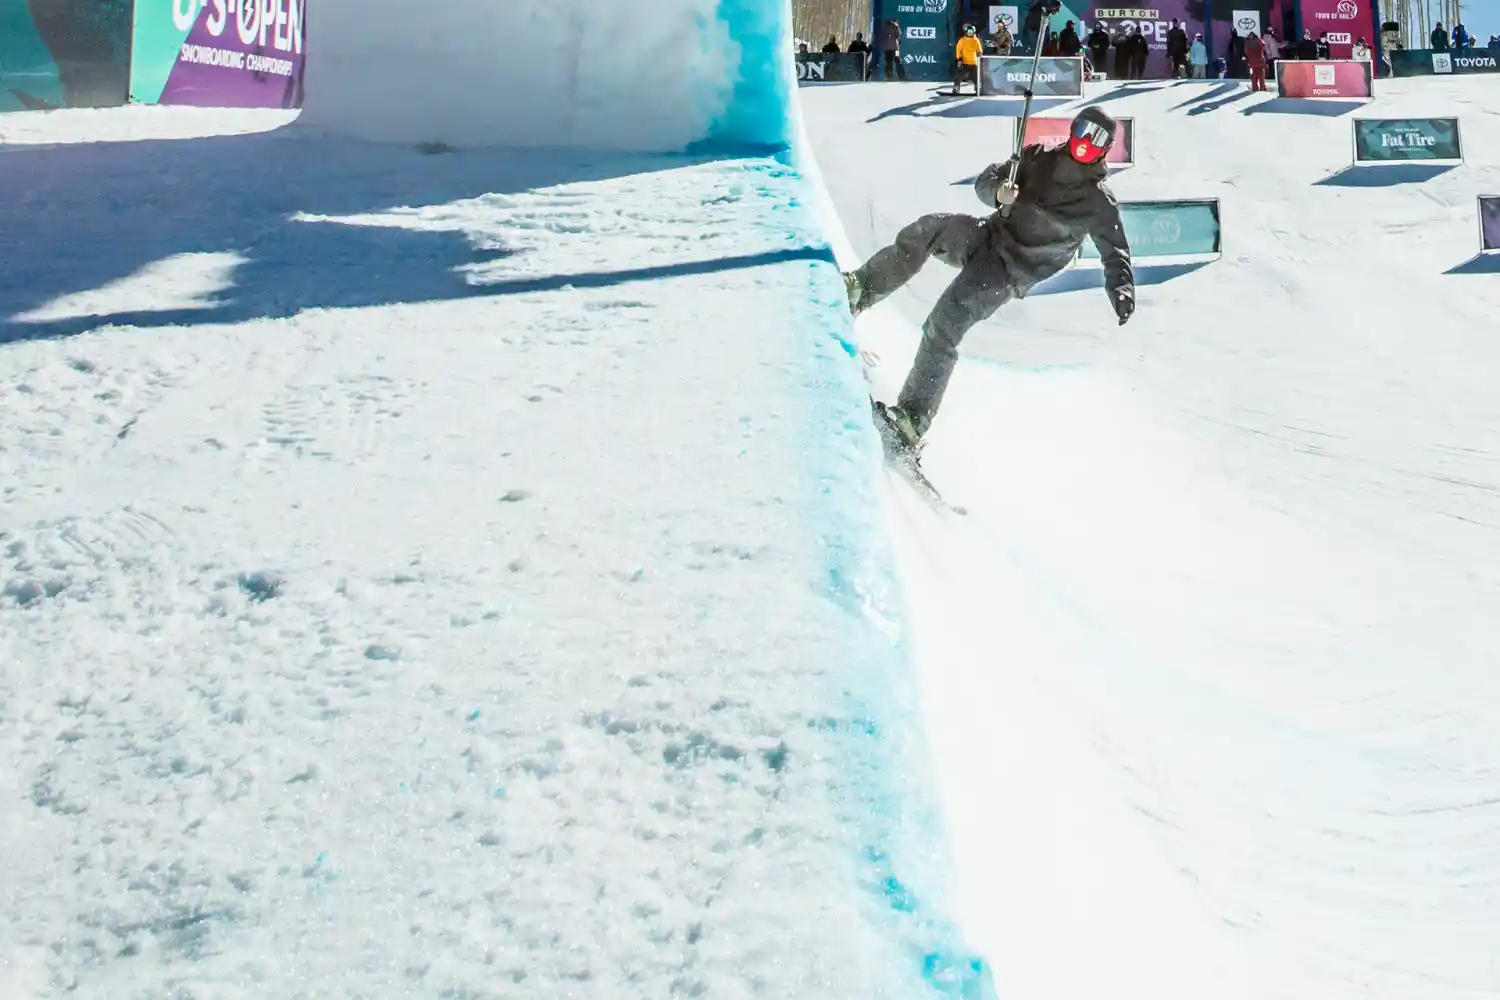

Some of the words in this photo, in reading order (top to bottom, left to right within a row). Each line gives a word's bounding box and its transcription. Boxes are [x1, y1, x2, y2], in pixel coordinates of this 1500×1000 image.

[1097, 9, 1157, 18] BURTON
[910, 28, 933, 37] CLIF
[1329, 34, 1349, 42] CLIF
[181, 43, 244, 69] SNOWBOARDING
[914, 55, 937, 63] VAIL
[1454, 57, 1496, 67] TOYOTA
[1006, 72, 1056, 83] BURON
[1381, 133, 1404, 146] Fat
[1405, 132, 1435, 146] Tire
